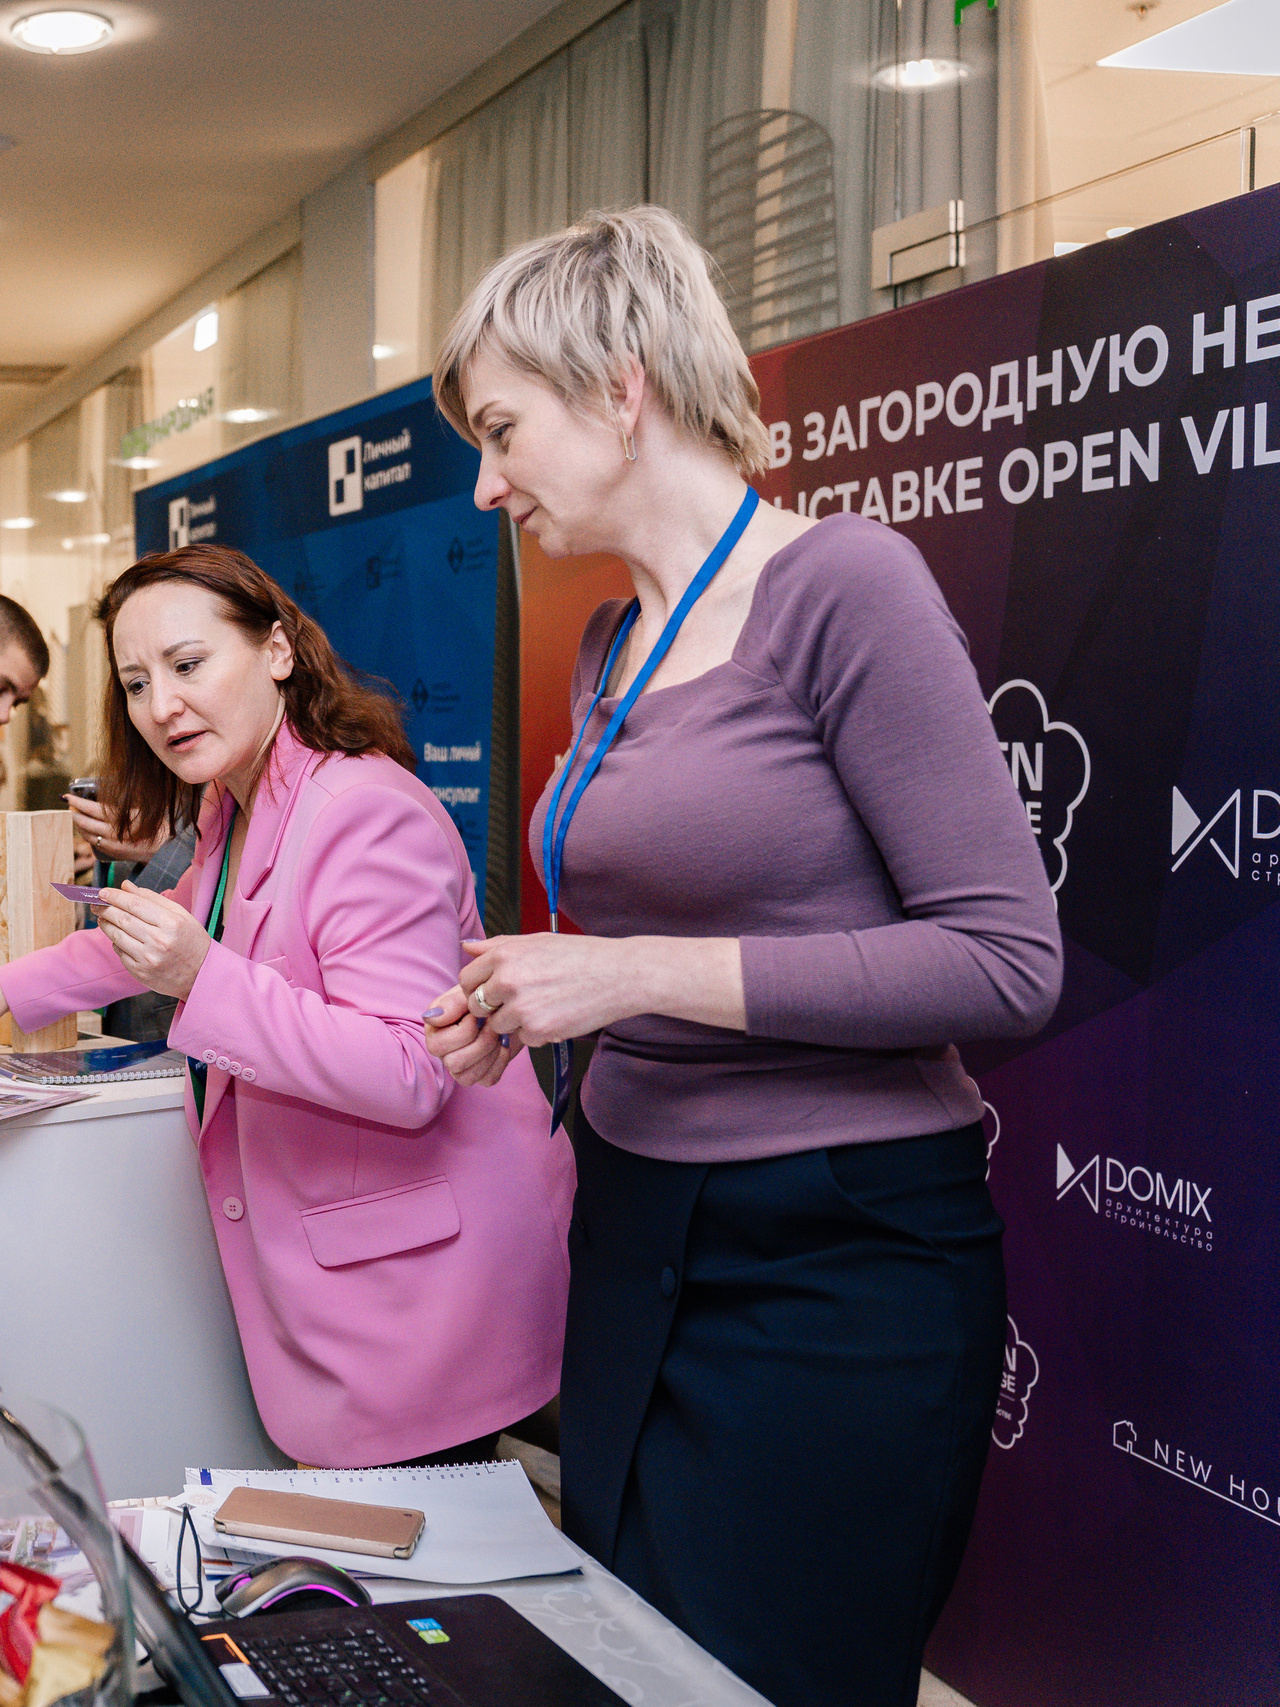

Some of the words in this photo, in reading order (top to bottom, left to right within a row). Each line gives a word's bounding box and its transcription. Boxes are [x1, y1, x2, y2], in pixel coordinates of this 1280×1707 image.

[802, 324, 1169, 462] ЗАГОРОДНУЮ
[363, 428, 412, 463] Личный
[773, 456, 984, 525] СТАВКЕ
[998, 421, 1161, 505] OPEN
[1180, 401, 1280, 476] VIL
[1106, 1157, 1212, 1223] DOMIX
[1105, 1198, 1213, 1240] архитектура
[1105, 1209, 1213, 1252] строительство
[1154, 1438, 1212, 1484] NEW
